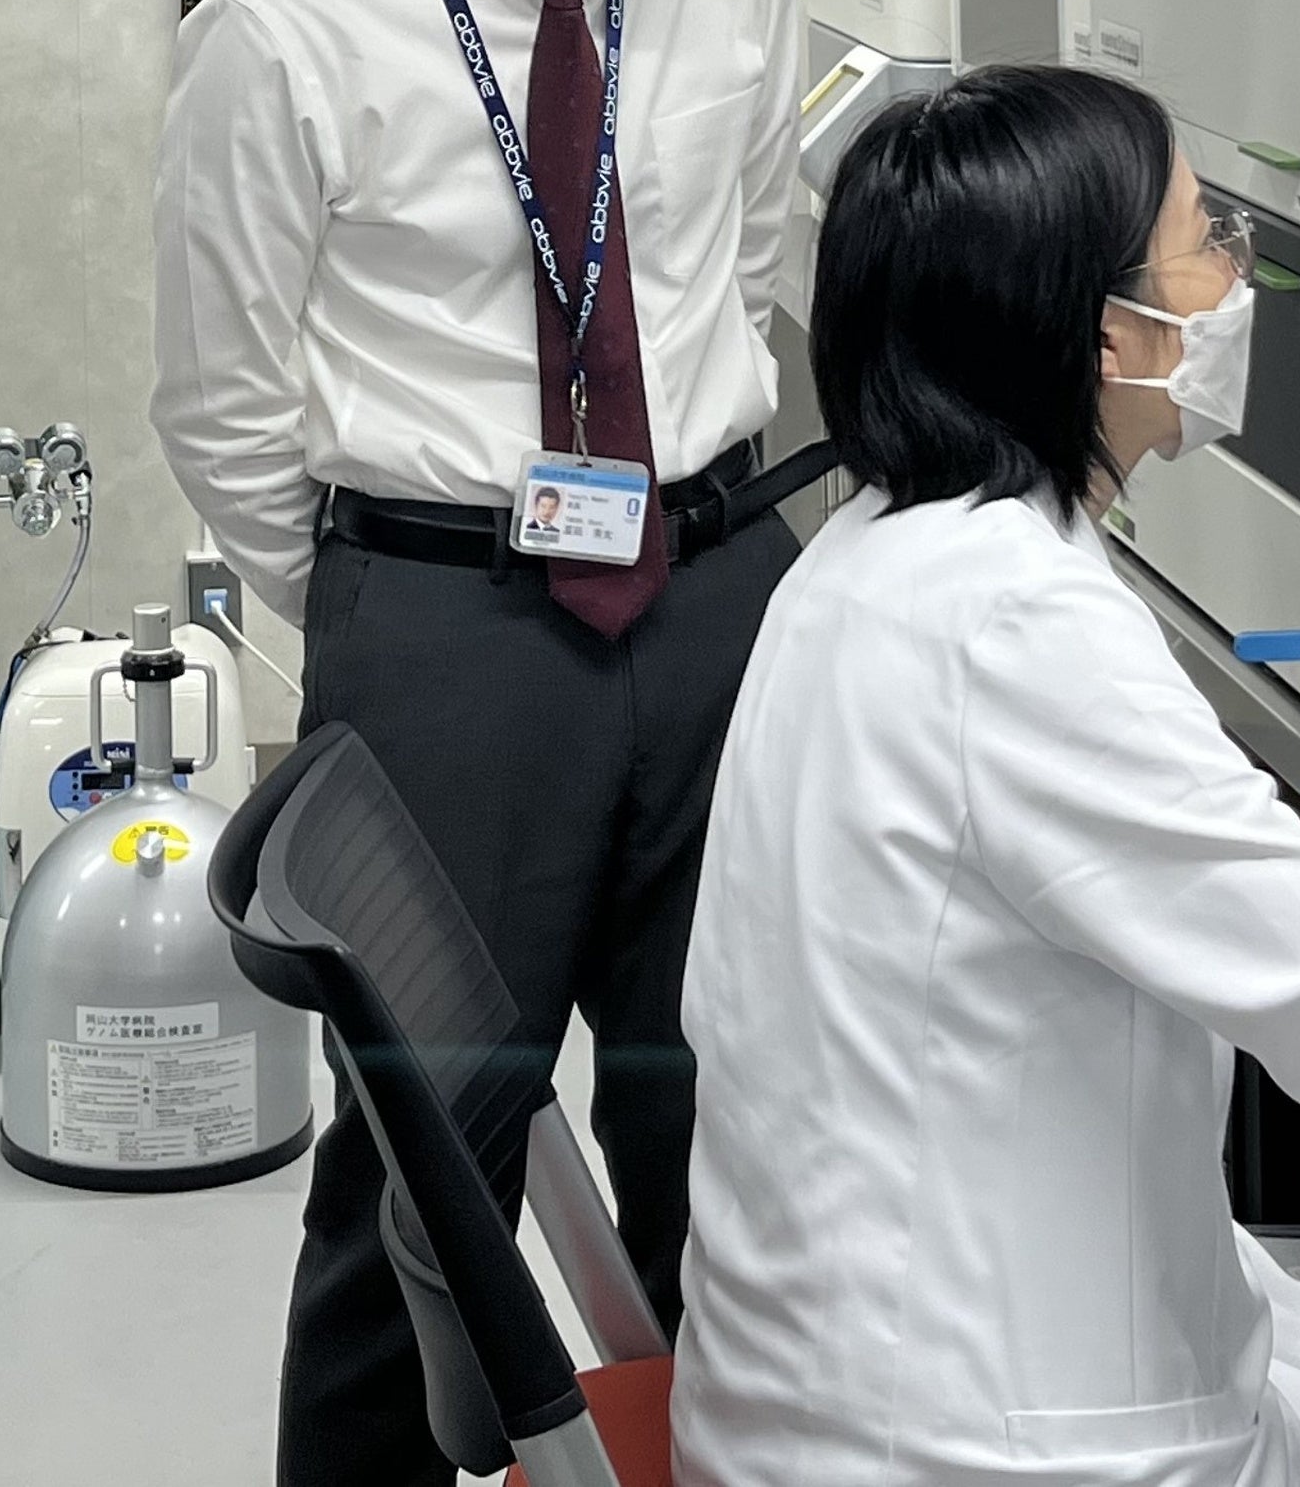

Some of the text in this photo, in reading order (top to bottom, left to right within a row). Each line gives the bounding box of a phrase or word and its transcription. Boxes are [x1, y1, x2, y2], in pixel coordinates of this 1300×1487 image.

[453, 12, 497, 100] abbvie
[603, 46, 620, 136] abbvie
[492, 114, 534, 202] abbvie
[589, 153, 613, 244] abbvie
[529, 217, 569, 305] abbvie
